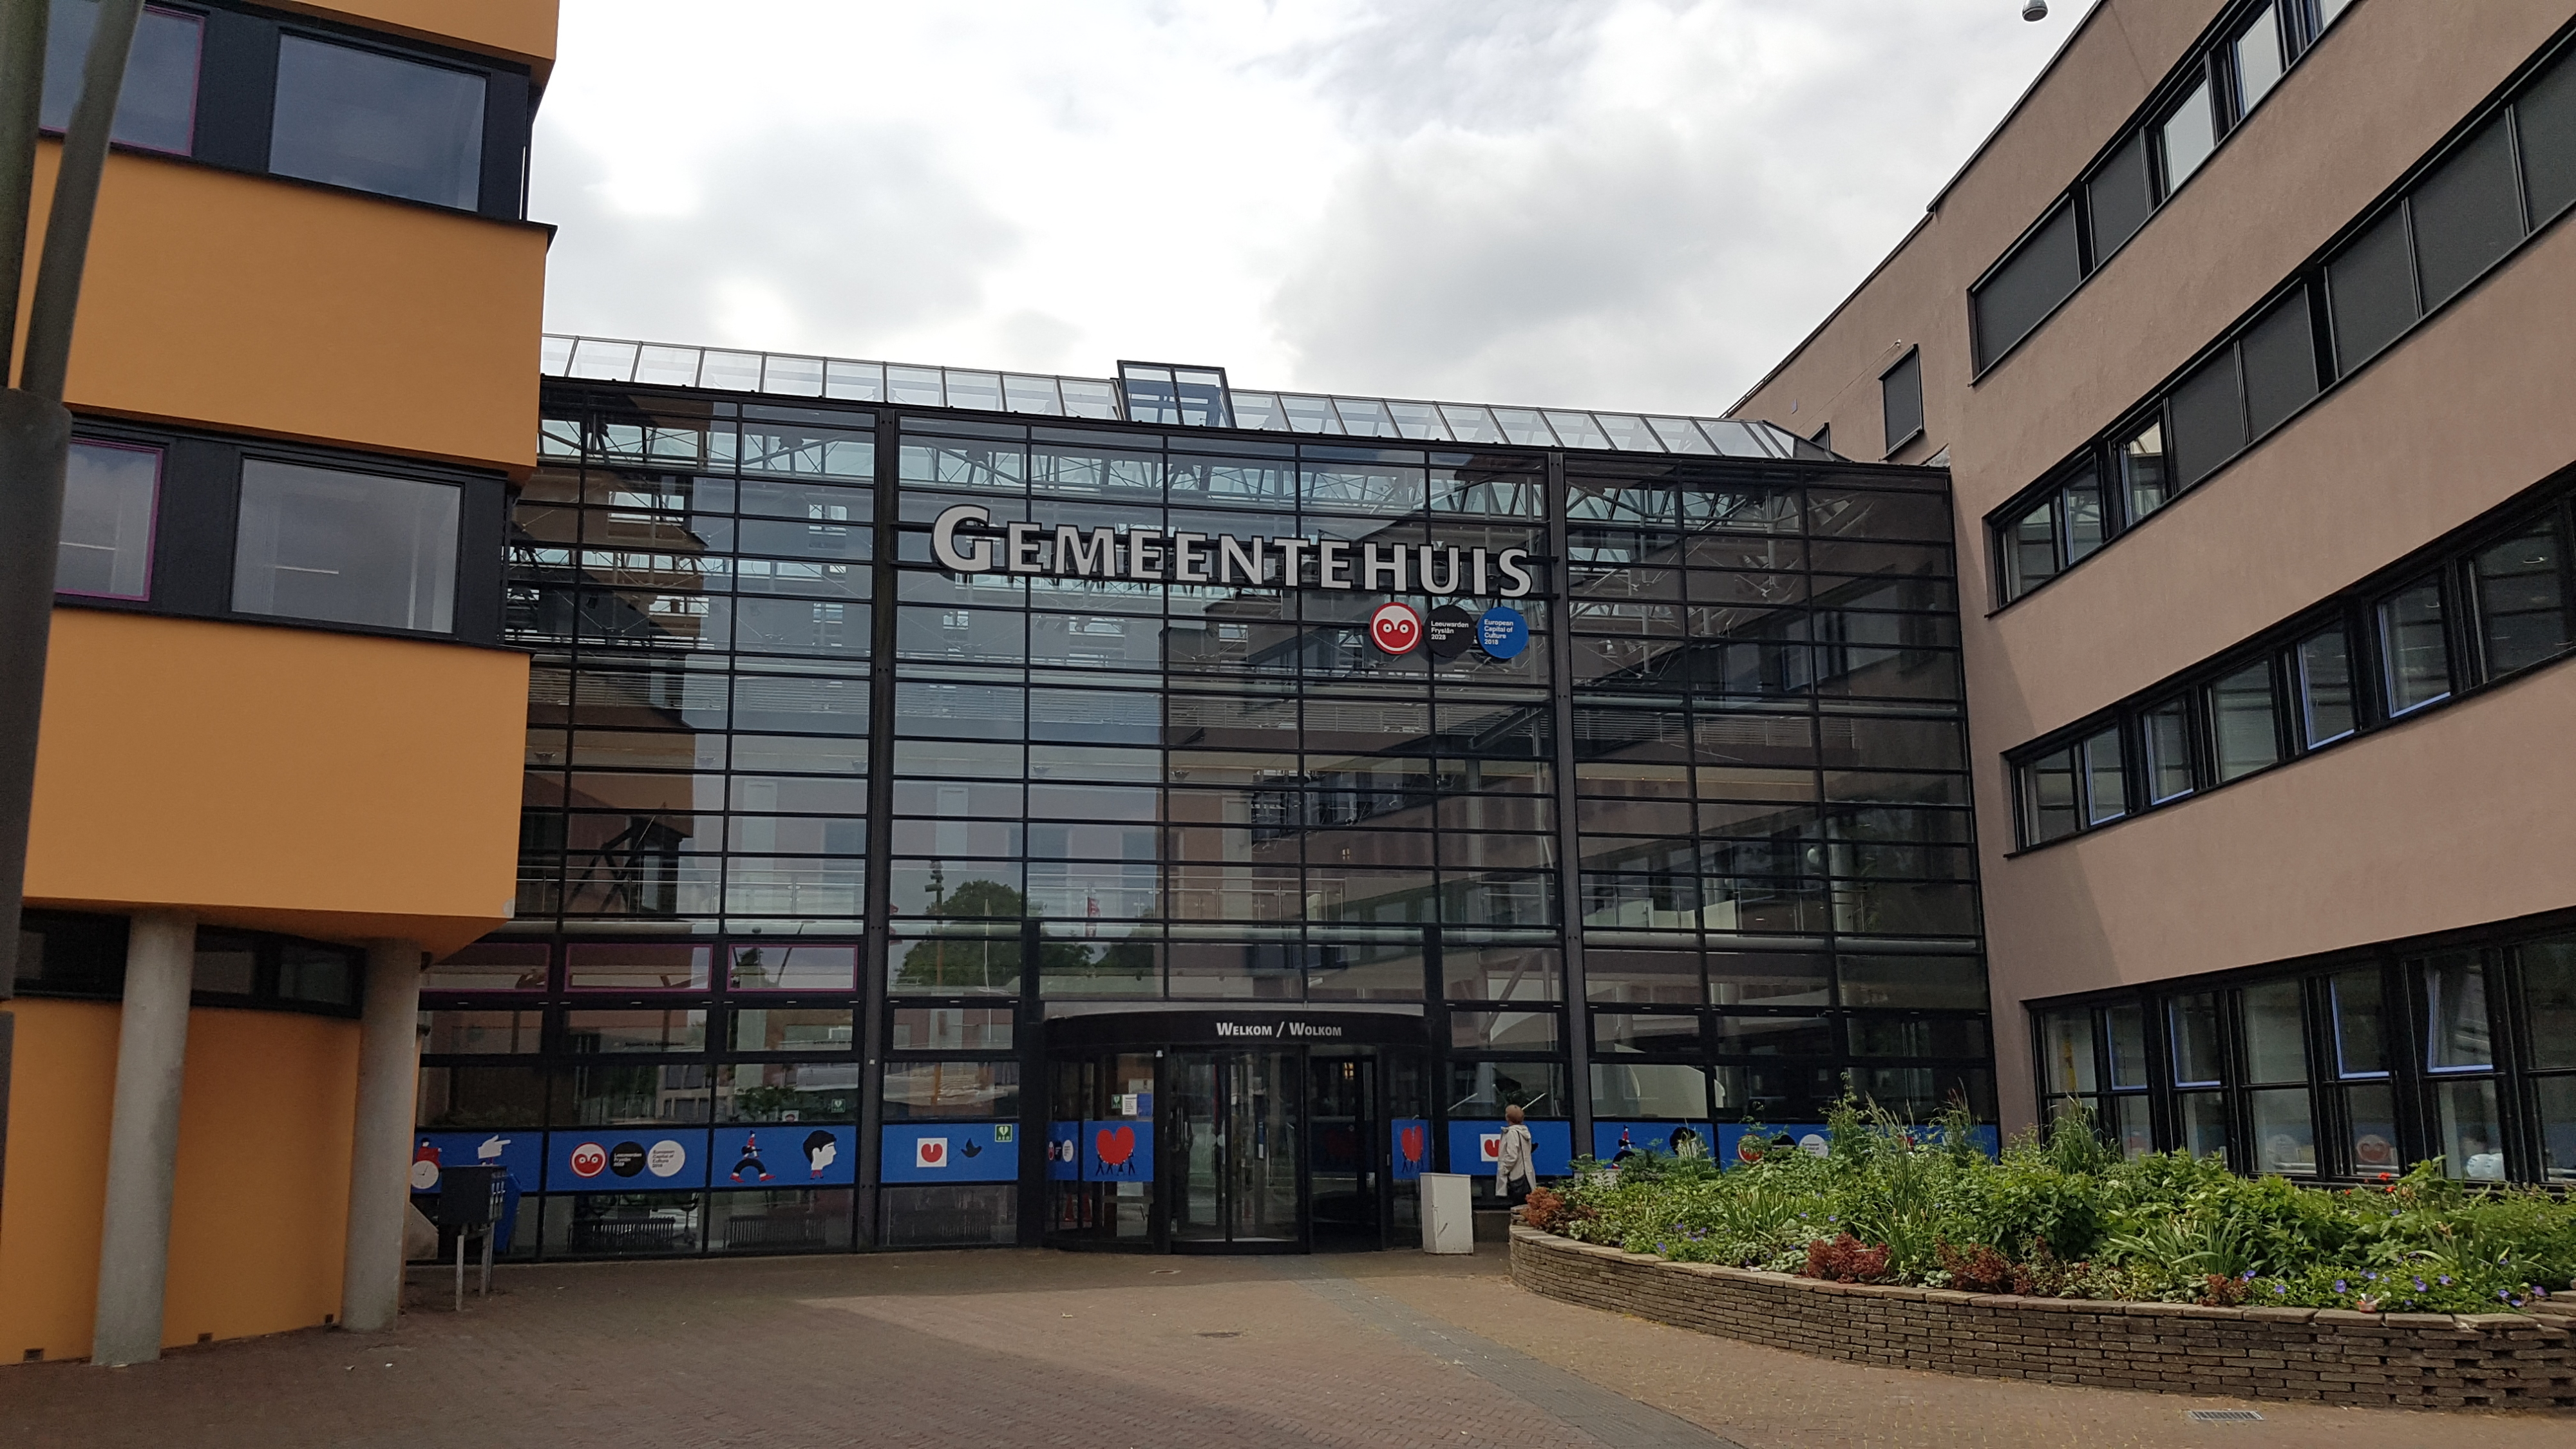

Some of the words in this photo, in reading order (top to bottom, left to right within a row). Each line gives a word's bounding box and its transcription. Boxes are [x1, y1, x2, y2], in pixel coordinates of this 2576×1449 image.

[931, 504, 1532, 598] GEMEENTEHUIS
[1216, 1022, 1273, 1036] WELKOM
[1289, 1022, 1342, 1036] WOLKOM
